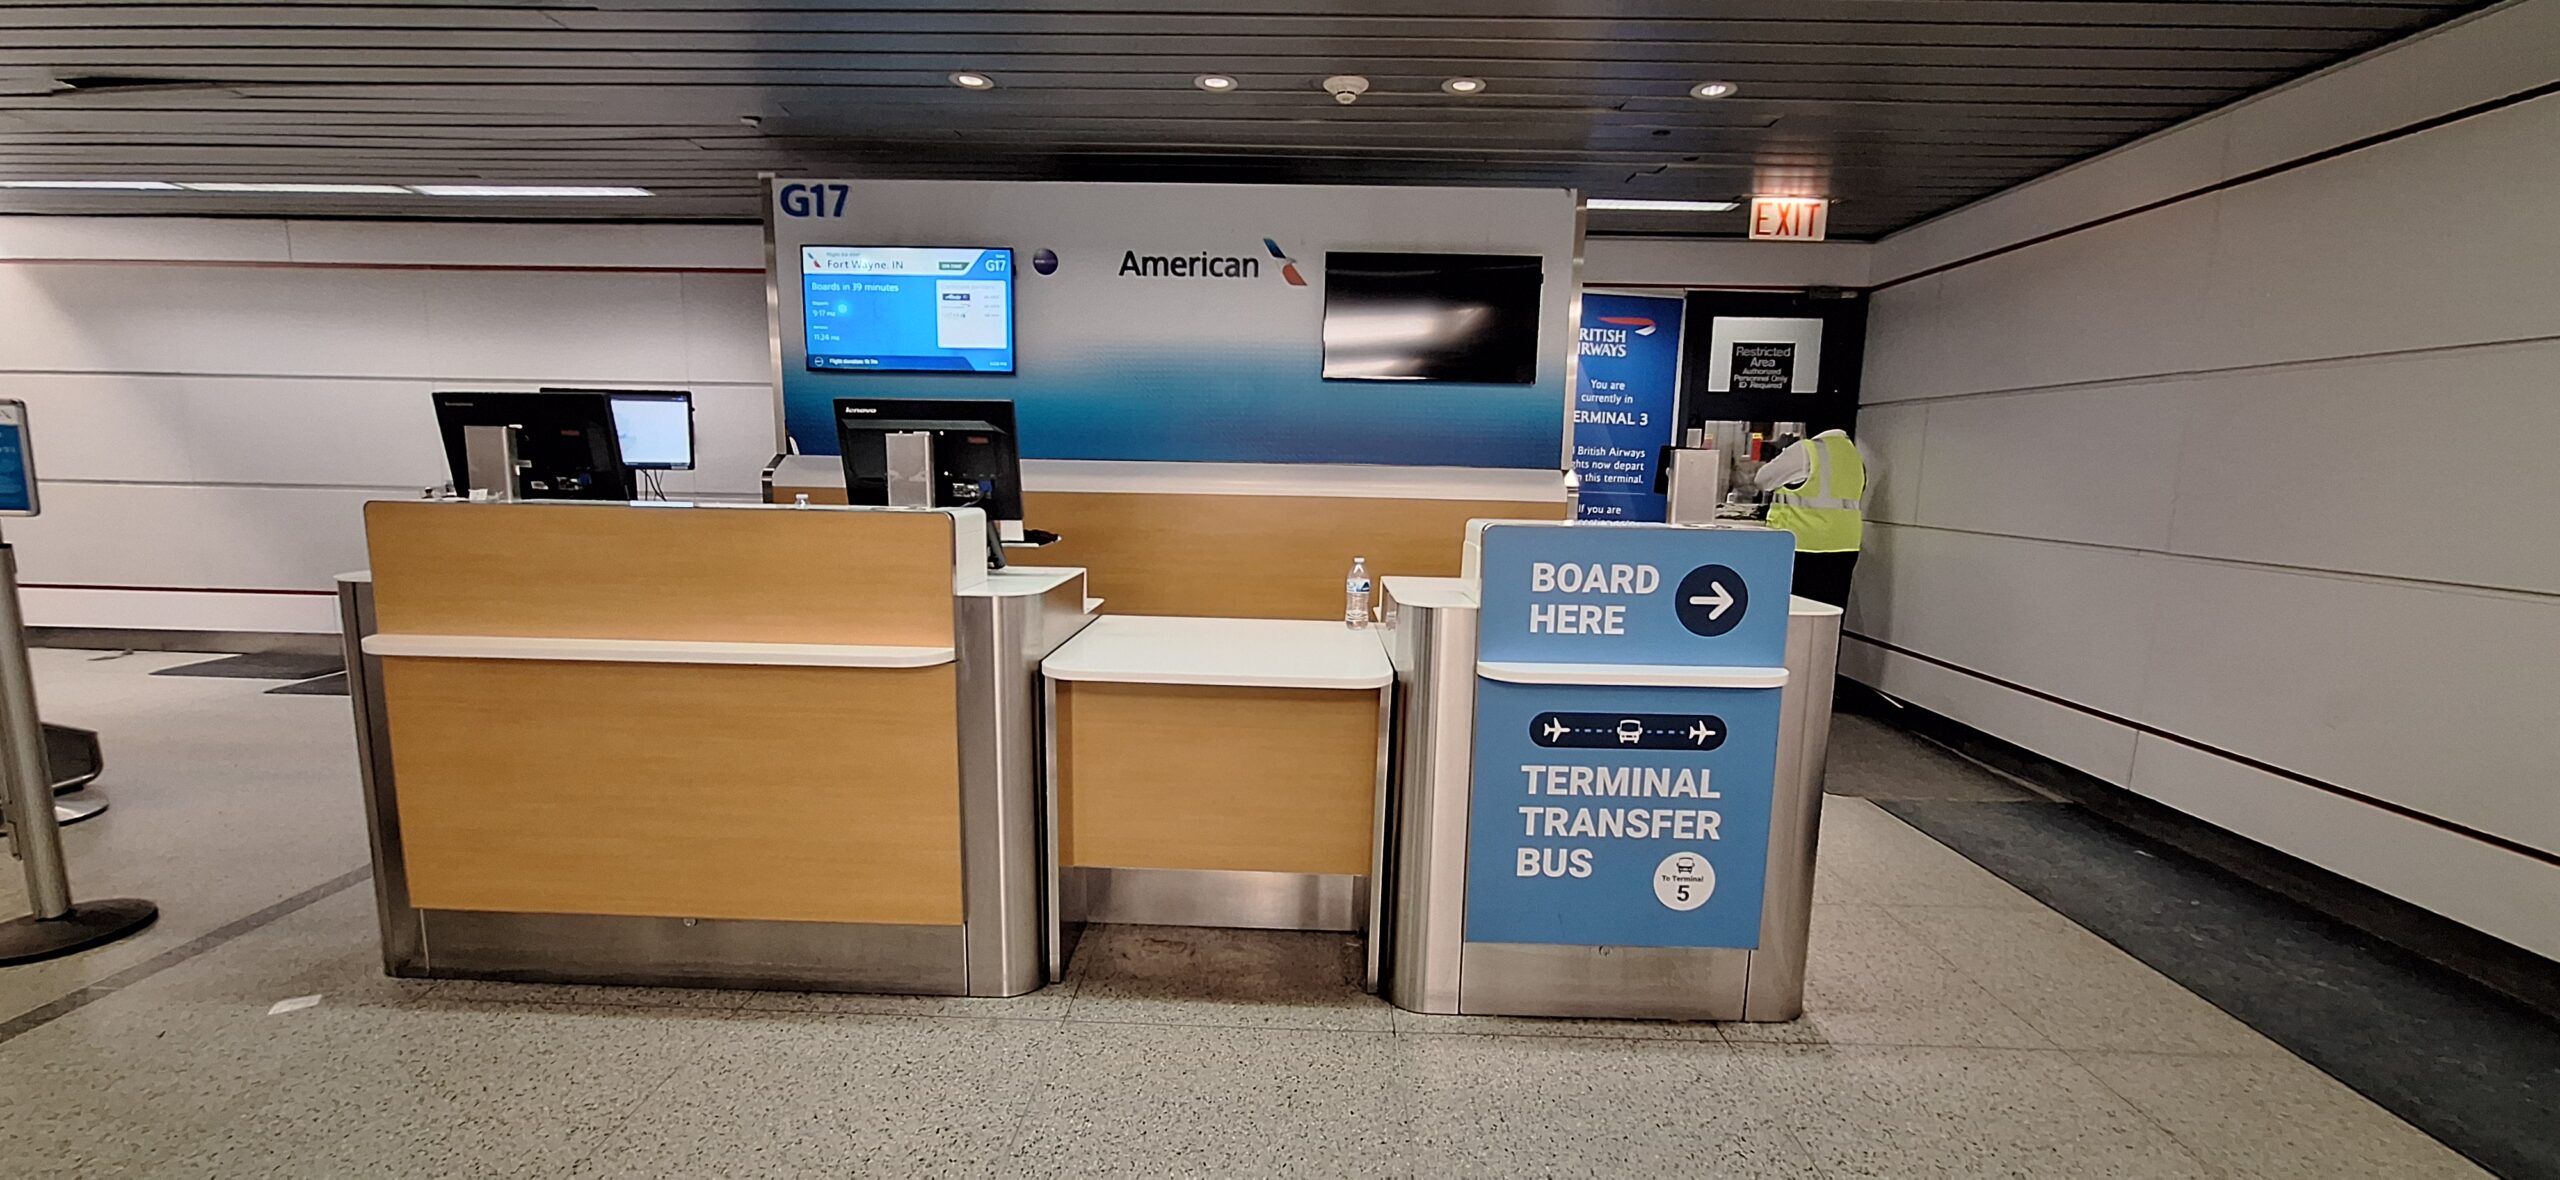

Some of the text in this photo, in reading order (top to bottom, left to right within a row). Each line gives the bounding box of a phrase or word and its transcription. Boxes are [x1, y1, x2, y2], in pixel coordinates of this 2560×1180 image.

[780, 183, 849, 217] G17
[1755, 202, 1821, 237] EXIT
[827, 259, 849, 269] Fort
[892, 260, 904, 269] IN
[985, 259, 1006, 272] G17
[1118, 250, 1259, 278] American
[811, 282, 840, 291] Boards
[843, 283, 850, 291] in
[864, 283, 899, 292] minutes
[1579, 327, 1627, 343] RITISH
[1577, 341, 1627, 358] IRWAYS
[1736, 346, 1791, 357] Restricted
[1750, 357, 1776, 368] Area
[1590, 379, 1626, 390] You are
[1738, 381, 1783, 390] ID Required
[1771, 375, 1788, 384] Only
[1581, 393, 1633, 405] currently in
[1573, 410, 1648, 426] ERMINAL 3
[1577, 445, 1606, 457] British
[1609, 446, 1645, 460] Airways
[1572, 458, 1644, 472] ghts now depart
[1585, 472, 1601, 483] this
[1604, 473, 1644, 484] terminal.
[1578, 504, 1622, 516] If you are
[1531, 561, 1660, 595] BOARD
[1529, 604, 1626, 636] HERE
[1521, 765, 1721, 799] TERMINAL
[1518, 806, 1721, 841] TRANSFER
[1516, 848, 1594, 878] BUS
[1661, 874, 1704, 883] To Terminal
[1676, 884, 1690, 902] 5
